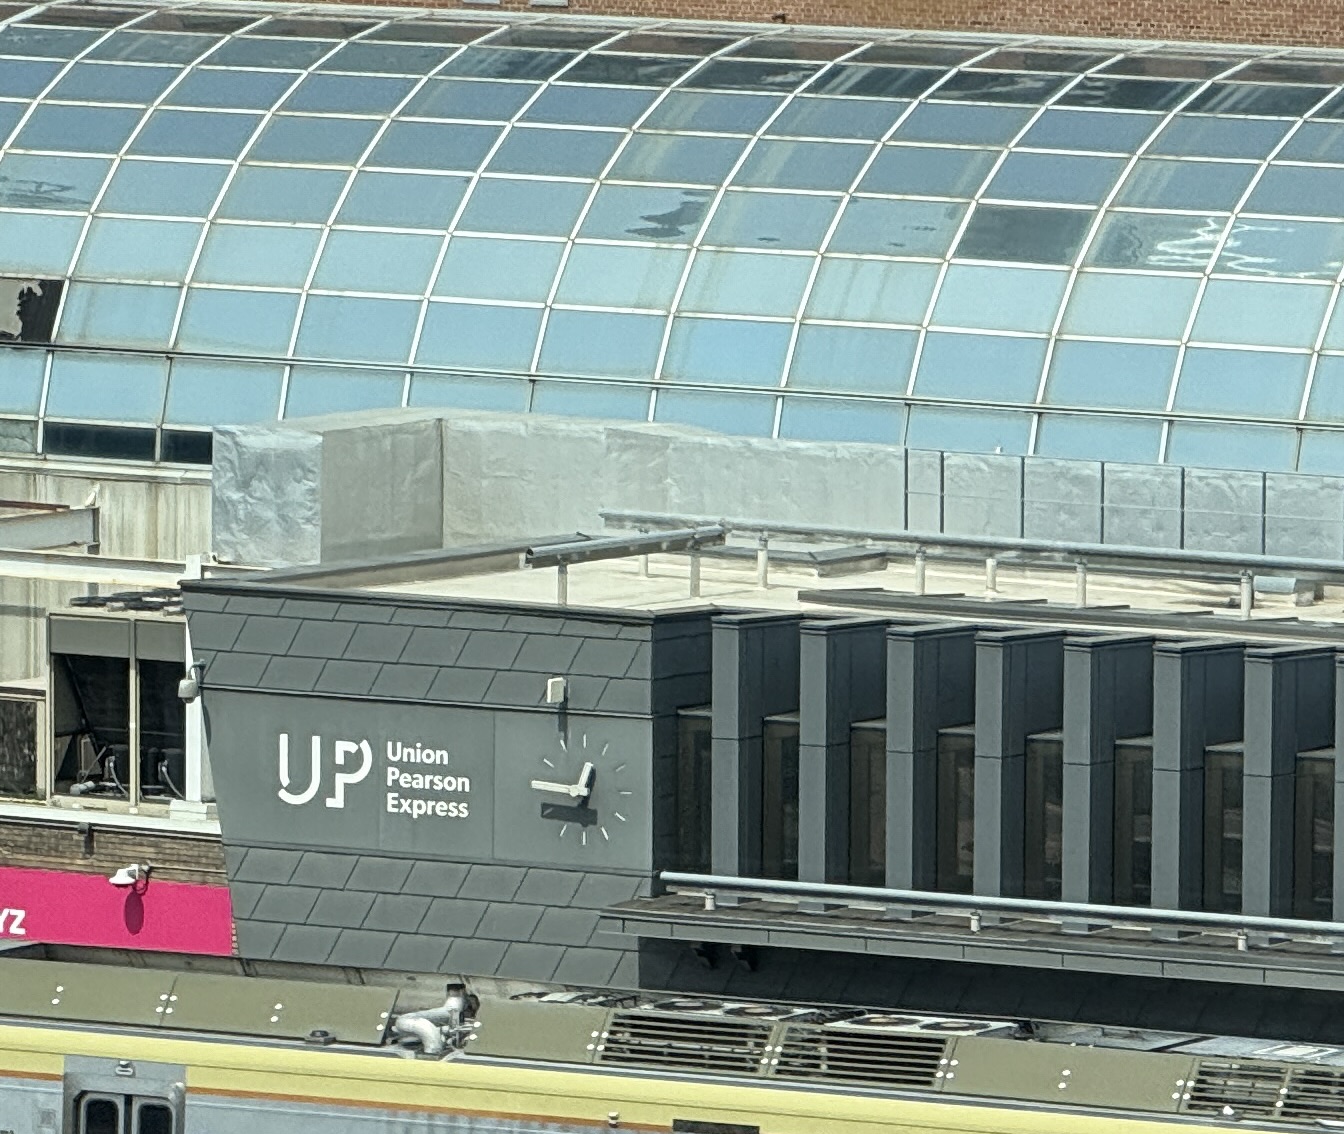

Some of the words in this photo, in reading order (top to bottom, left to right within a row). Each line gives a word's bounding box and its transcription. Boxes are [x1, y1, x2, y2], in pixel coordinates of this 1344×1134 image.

[387, 741, 449, 765] Union
[278, 733, 373, 808] UP
[386, 766, 471, 792] Pearson
[386, 792, 470, 818] Express
